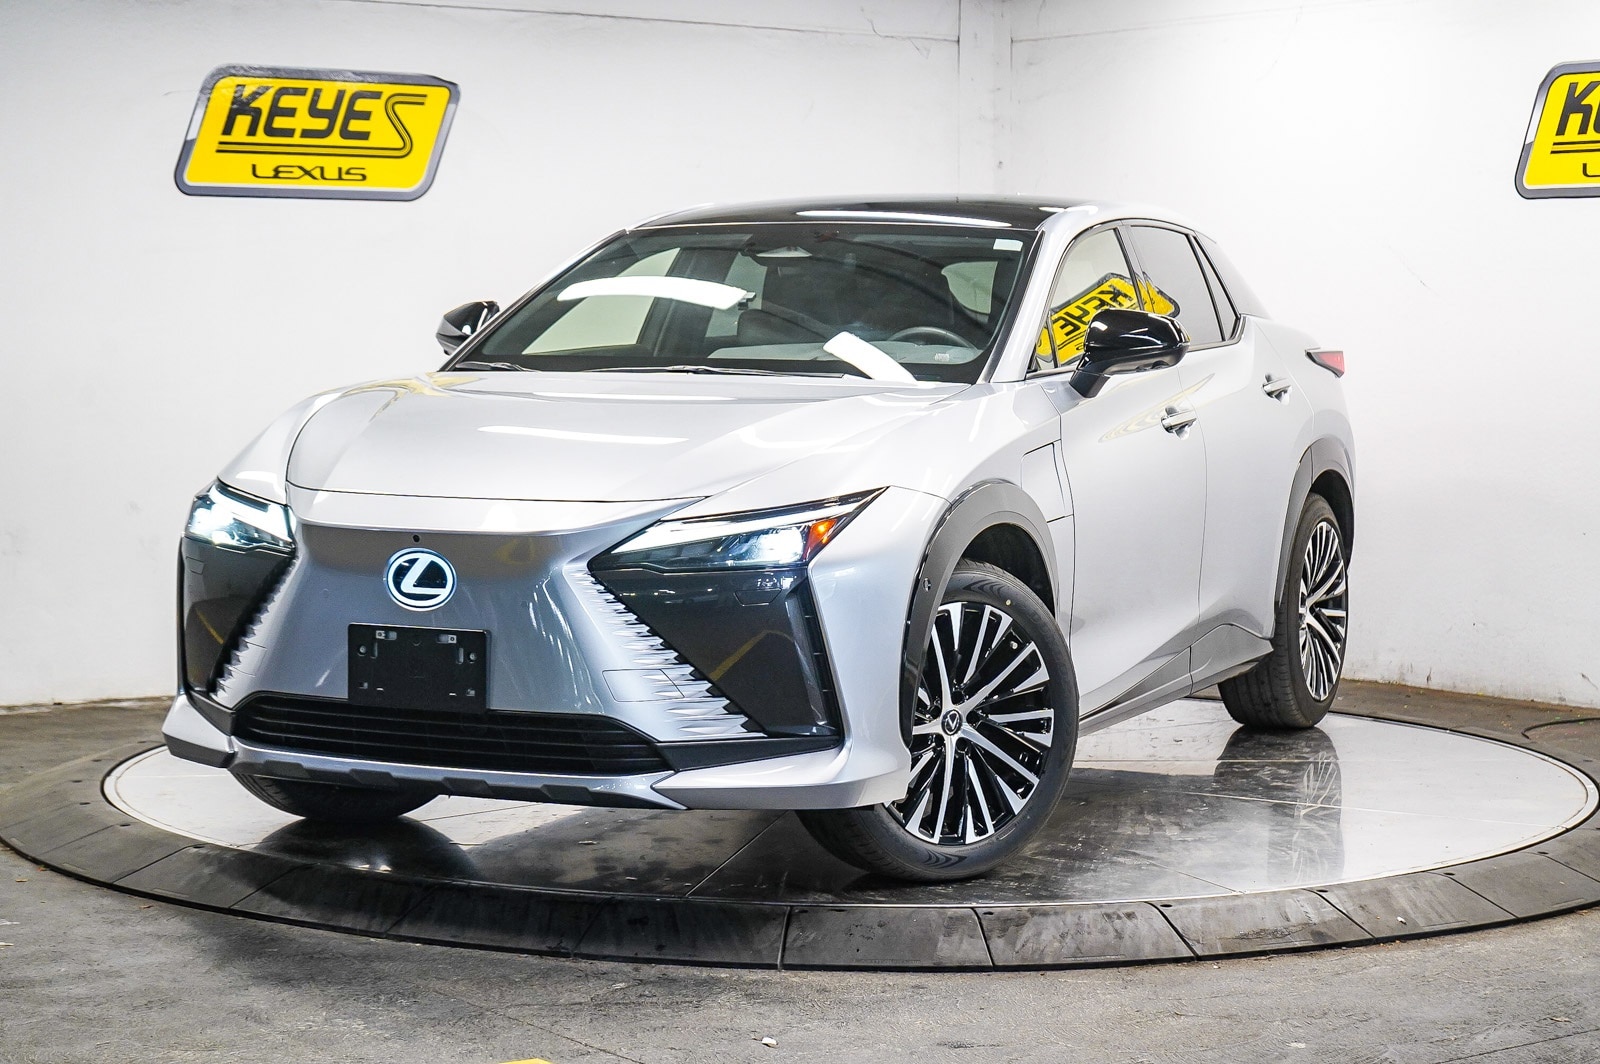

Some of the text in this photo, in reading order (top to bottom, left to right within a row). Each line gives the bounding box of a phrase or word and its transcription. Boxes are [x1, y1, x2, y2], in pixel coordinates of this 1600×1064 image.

[216, 83, 428, 158] KEYES
[1555, 80, 1600, 137] K
[251, 163, 367, 181] LEXUS
